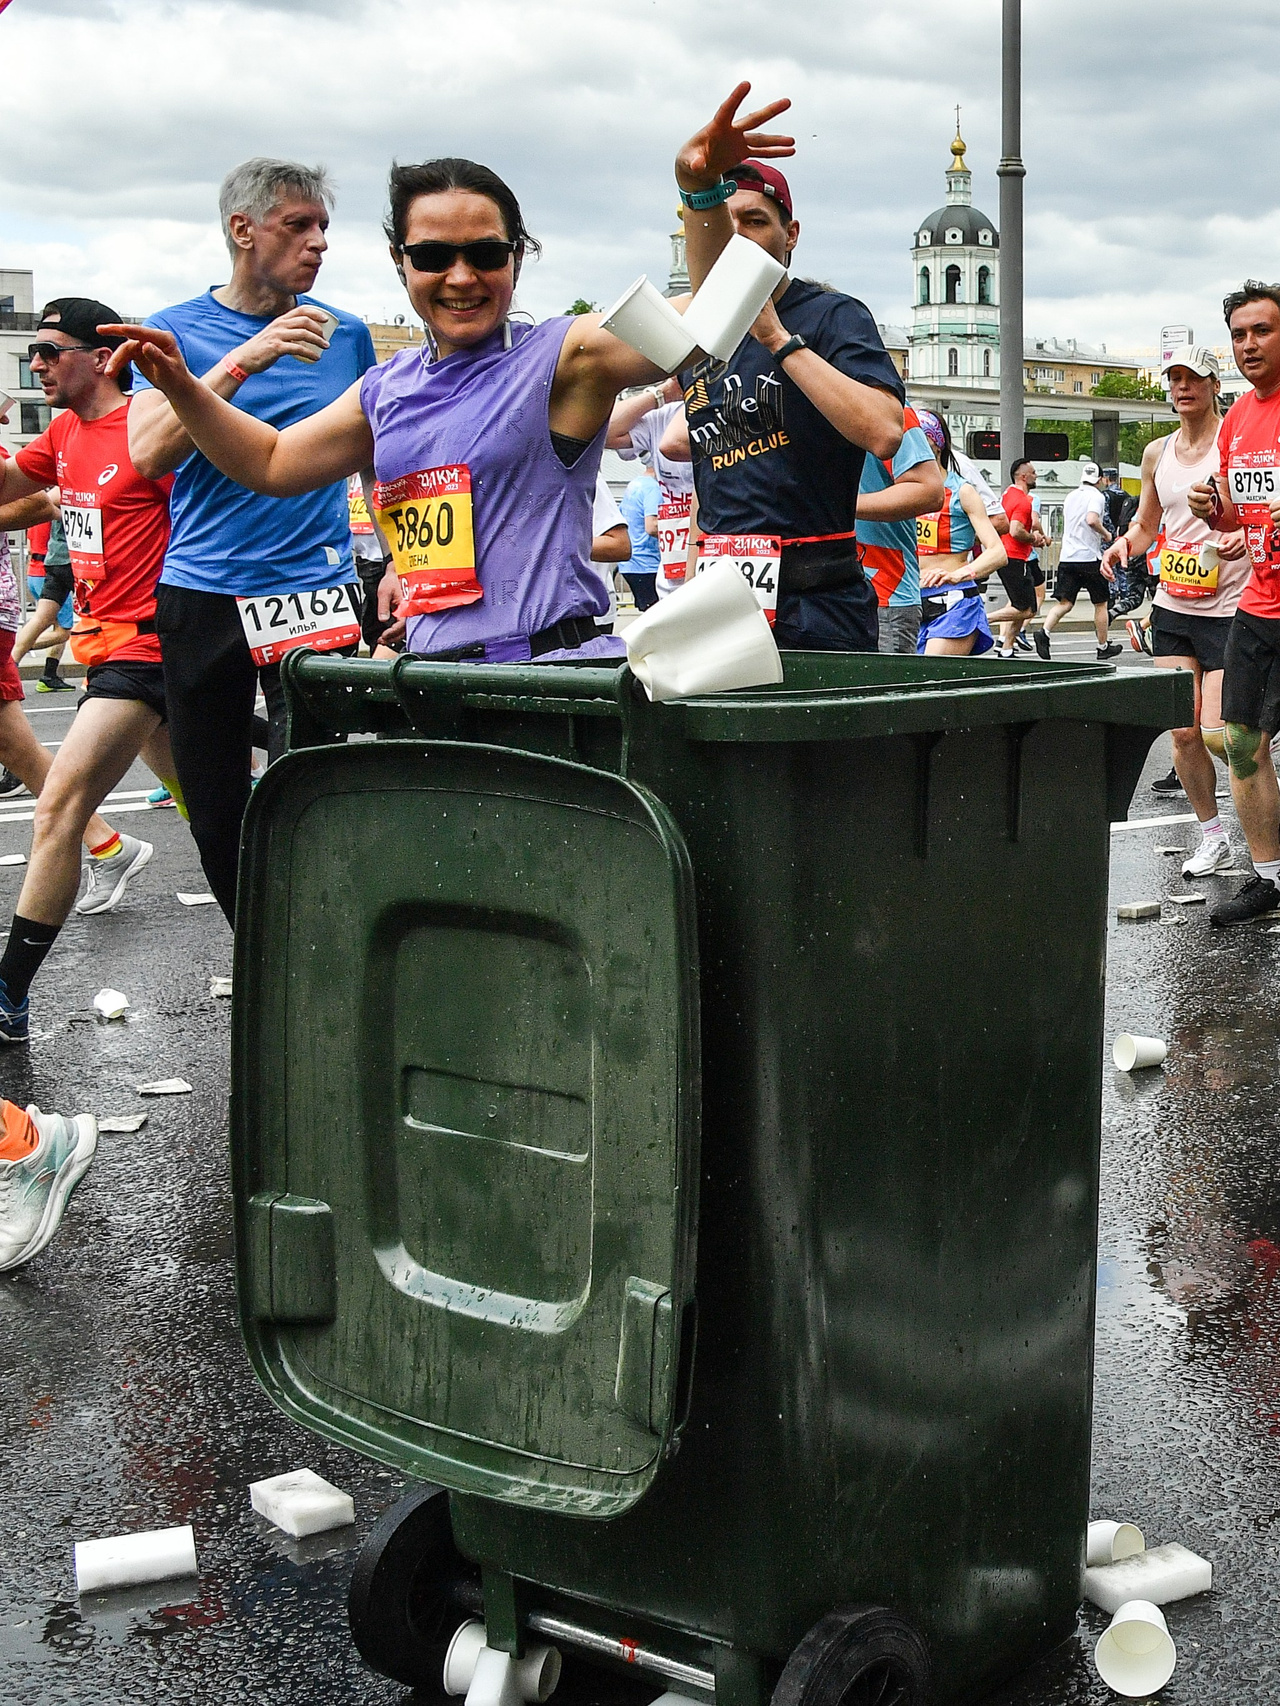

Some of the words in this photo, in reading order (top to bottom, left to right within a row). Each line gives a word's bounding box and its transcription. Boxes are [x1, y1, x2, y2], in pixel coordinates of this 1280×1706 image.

[712, 446, 746, 472] RUN
[747, 431, 790, 456] CLUE
[1234, 471, 1275, 493] 8795
[388, 502, 454, 552] 5860
[244, 587, 350, 632] 12162
[288, 621, 318, 635] ИЛЬЯ
[260, 646, 273, 663] F
